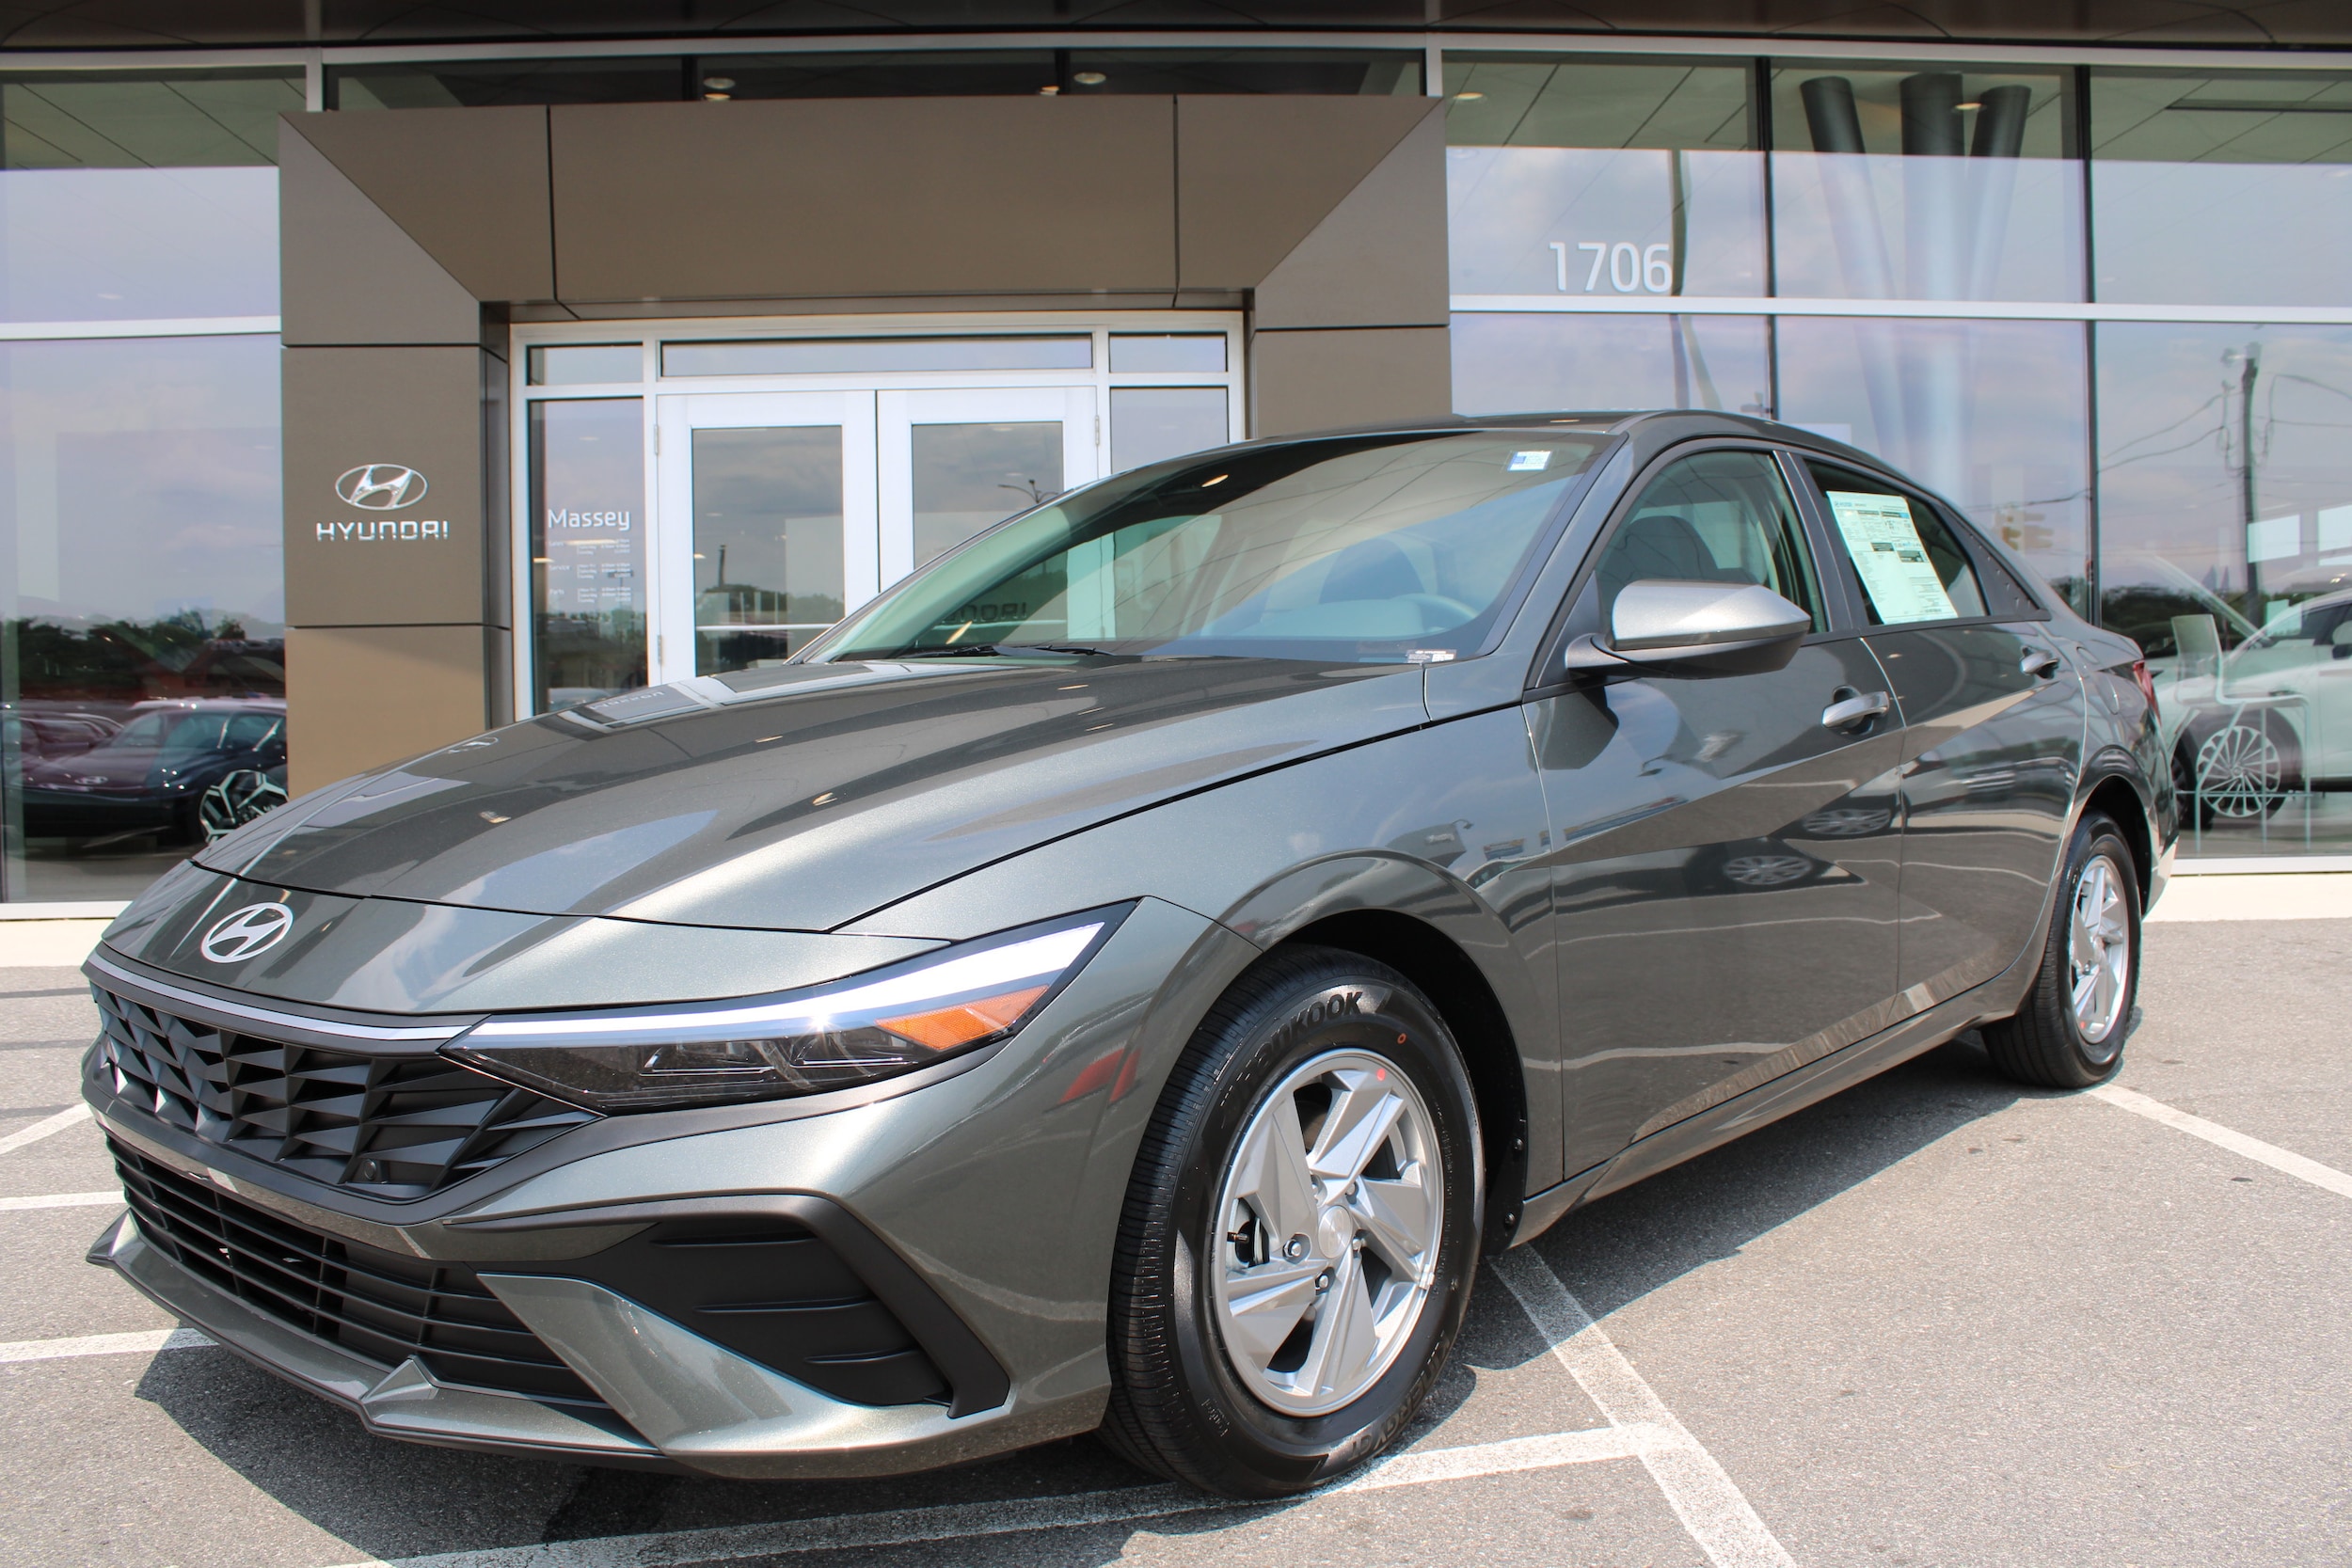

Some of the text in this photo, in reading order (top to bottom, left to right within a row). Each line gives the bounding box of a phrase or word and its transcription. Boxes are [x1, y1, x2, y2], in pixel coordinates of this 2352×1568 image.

[1549, 242, 1673, 293] 1706
[316, 520, 449, 542] HYUNDAI
[548, 508, 630, 531] Massey
